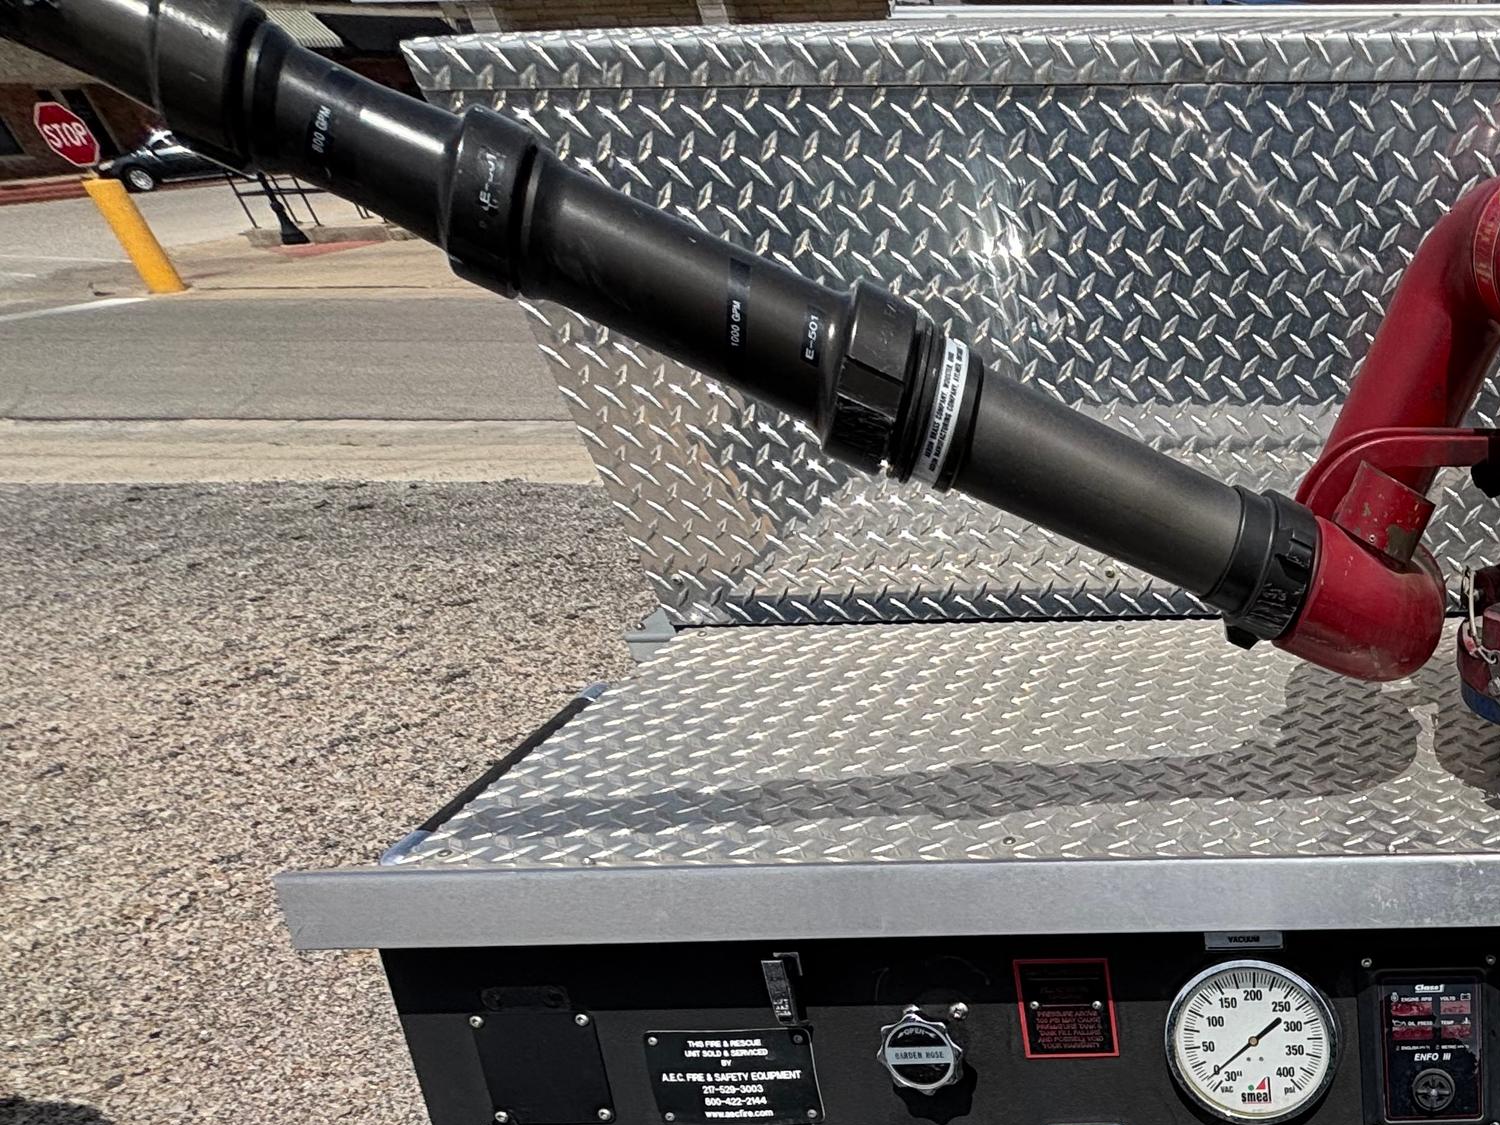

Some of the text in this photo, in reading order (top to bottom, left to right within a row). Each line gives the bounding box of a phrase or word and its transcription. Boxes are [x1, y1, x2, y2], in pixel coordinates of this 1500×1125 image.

[315, 105, 332, 131] GPM
[42, 122, 89, 149] STOP
[730, 300, 742, 348] 1000 GPM
[804, 314, 820, 360] E-501
[1243, 989, 1263, 1001] 200
[1219, 997, 1237, 1009] 150
[1271, 1001, 1291, 1012] 250
[1206, 1016, 1225, 1027] 100
[1283, 1021, 1303, 1033] 300
[903, 1027, 926, 1036] OPEN
[687, 1040, 704, 1048] THIS
[705, 1040, 722, 1048] FIRE
[730, 1039, 762, 1047] RESCUE
[1202, 1041, 1215, 1052] 50
[684, 1050, 701, 1058] UNIT
[702, 1050, 722, 1058] SOLD
[730, 1048, 769, 1057] SERVICED
[1285, 1044, 1305, 1056] 350
[1414, 1053, 1439, 1061] ENFO
[721, 1059, 732, 1067] BY
[1213, 1065, 1220, 1075] 0
[1276, 1066, 1295, 1078] 400
[686, 1073, 706, 1082] FIRE
[706, 1073, 713, 1082] &
[713, 1072, 749, 1082] SAFETY
[751, 1070, 802, 1081] EQUIPMENT
[1220, 1085, 1234, 1094] VAC
[1241, 1076, 1272, 1103] smeal
[1284, 1086, 1296, 1095] psi
[705, 1109, 774, 1118] www.aecfire.com
